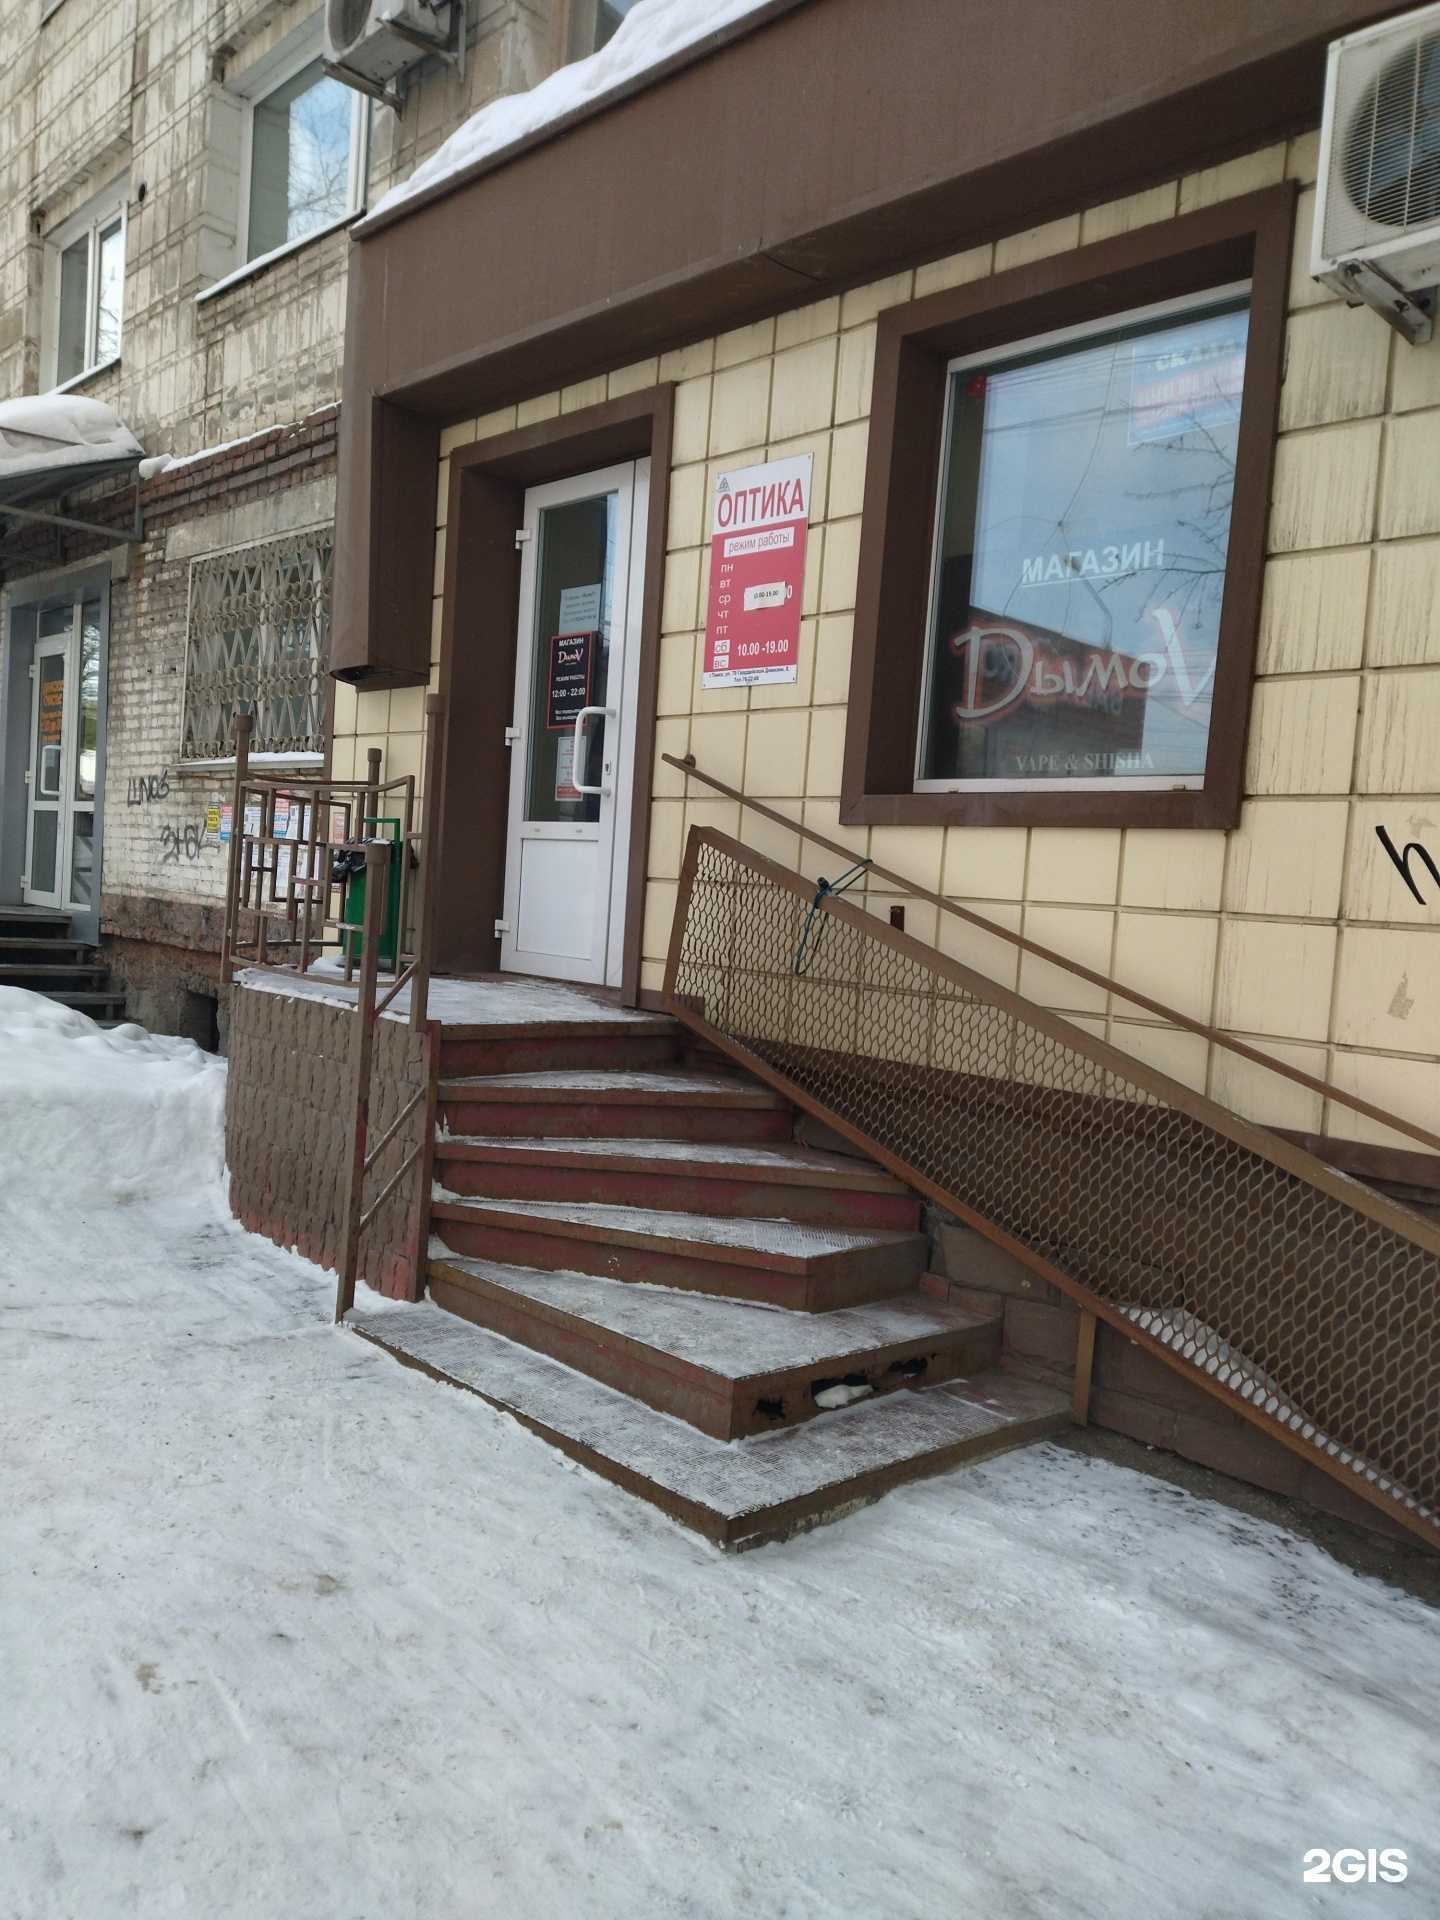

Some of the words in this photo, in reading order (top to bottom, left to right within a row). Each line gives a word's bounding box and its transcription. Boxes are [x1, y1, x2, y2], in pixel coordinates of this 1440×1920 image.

[718, 478, 804, 527] ОПТИКА
[728, 538, 756, 555] режим
[758, 532, 790, 553] работы
[1021, 539, 1165, 584] МАГАЗИН
[721, 563, 734, 573] пн
[719, 579, 731, 588] вт
[718, 594, 731, 606] ср
[717, 609, 729, 619] чт
[716, 625, 729, 635] пт
[559, 638, 584, 647] МАГАЗИН
[715, 640, 728, 652] сб
[714, 657, 727, 669] вс
[552, 689, 567, 698] 12:00
[570, 687, 586, 696] 22:00
[1016, 753, 1059, 771] VAPE
[1064, 753, 1079, 771] &
[1083, 751, 1154, 771] SHISHA
